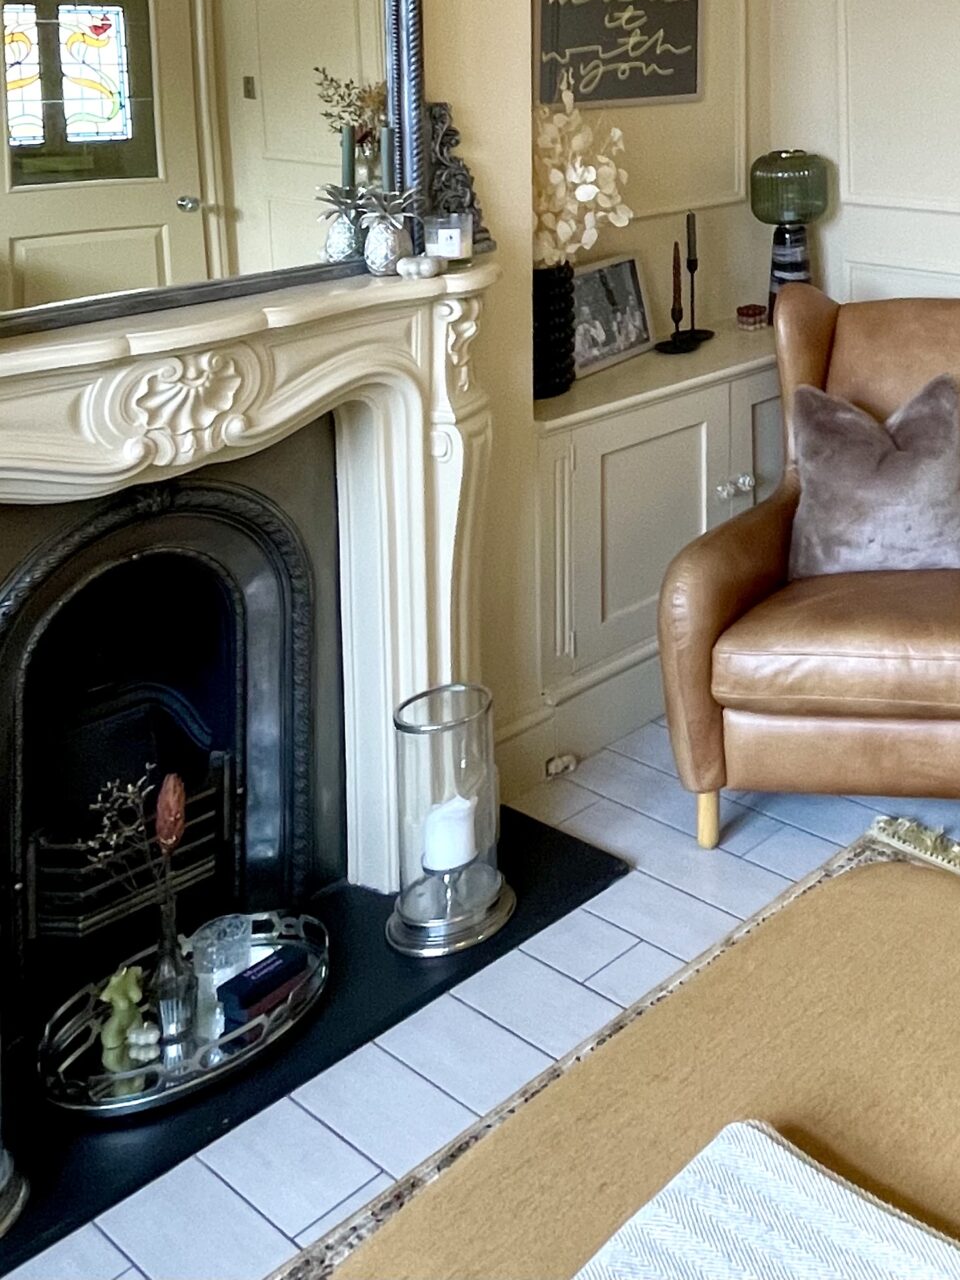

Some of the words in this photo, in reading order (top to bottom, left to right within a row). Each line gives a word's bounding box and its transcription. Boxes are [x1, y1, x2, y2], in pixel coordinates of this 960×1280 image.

[605, 5, 648, 30] it
[542, 28, 692, 64] with
[580, 58, 674, 93] you
